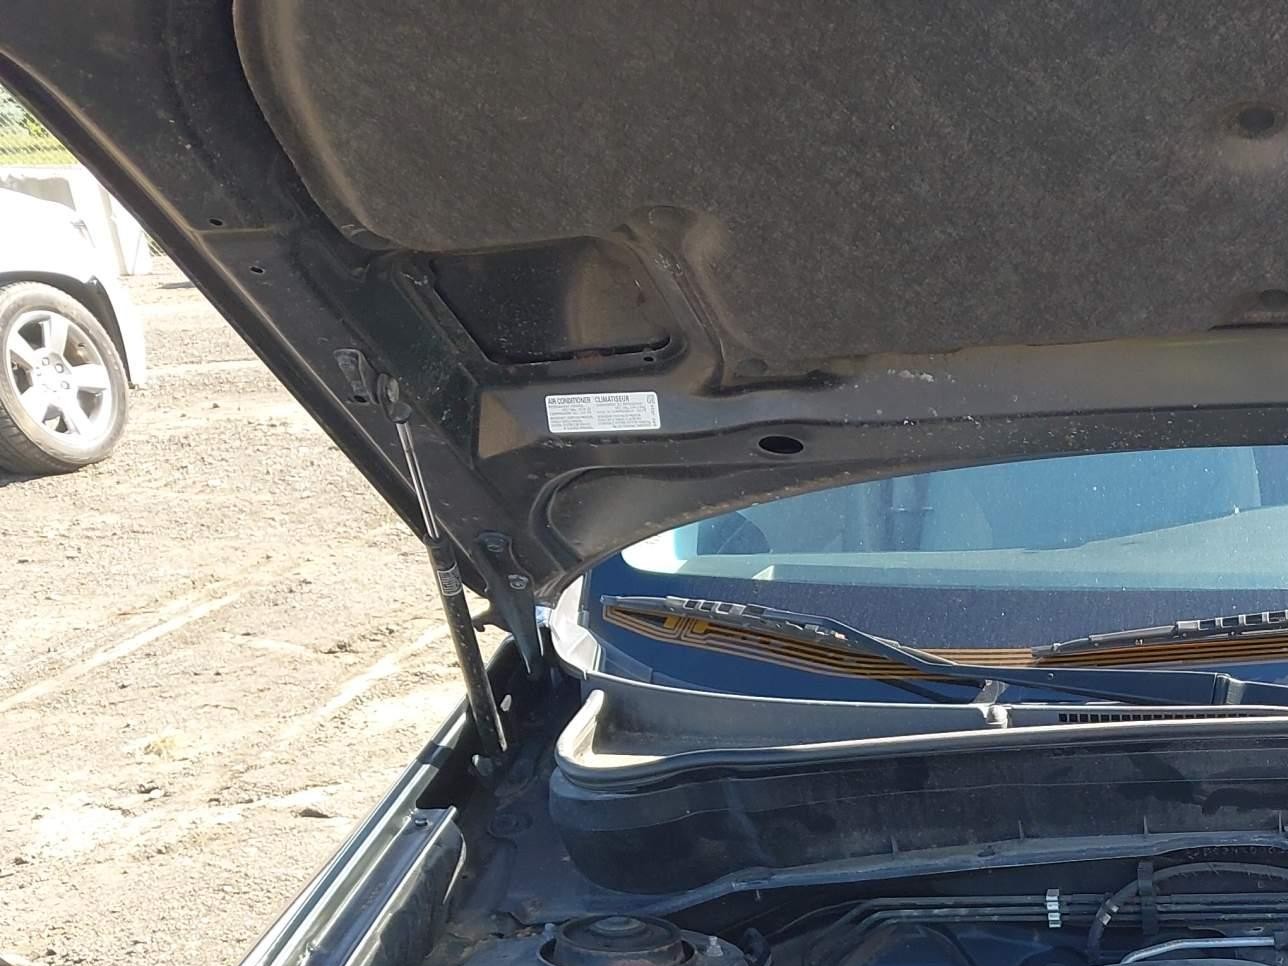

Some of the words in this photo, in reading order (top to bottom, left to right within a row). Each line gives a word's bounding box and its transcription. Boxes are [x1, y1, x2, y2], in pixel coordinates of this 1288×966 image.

[547, 397, 557, 405] AIR
[557, 396, 591, 404] CONDITIONER
[594, 395, 630, 403] CLIMATISEUR
